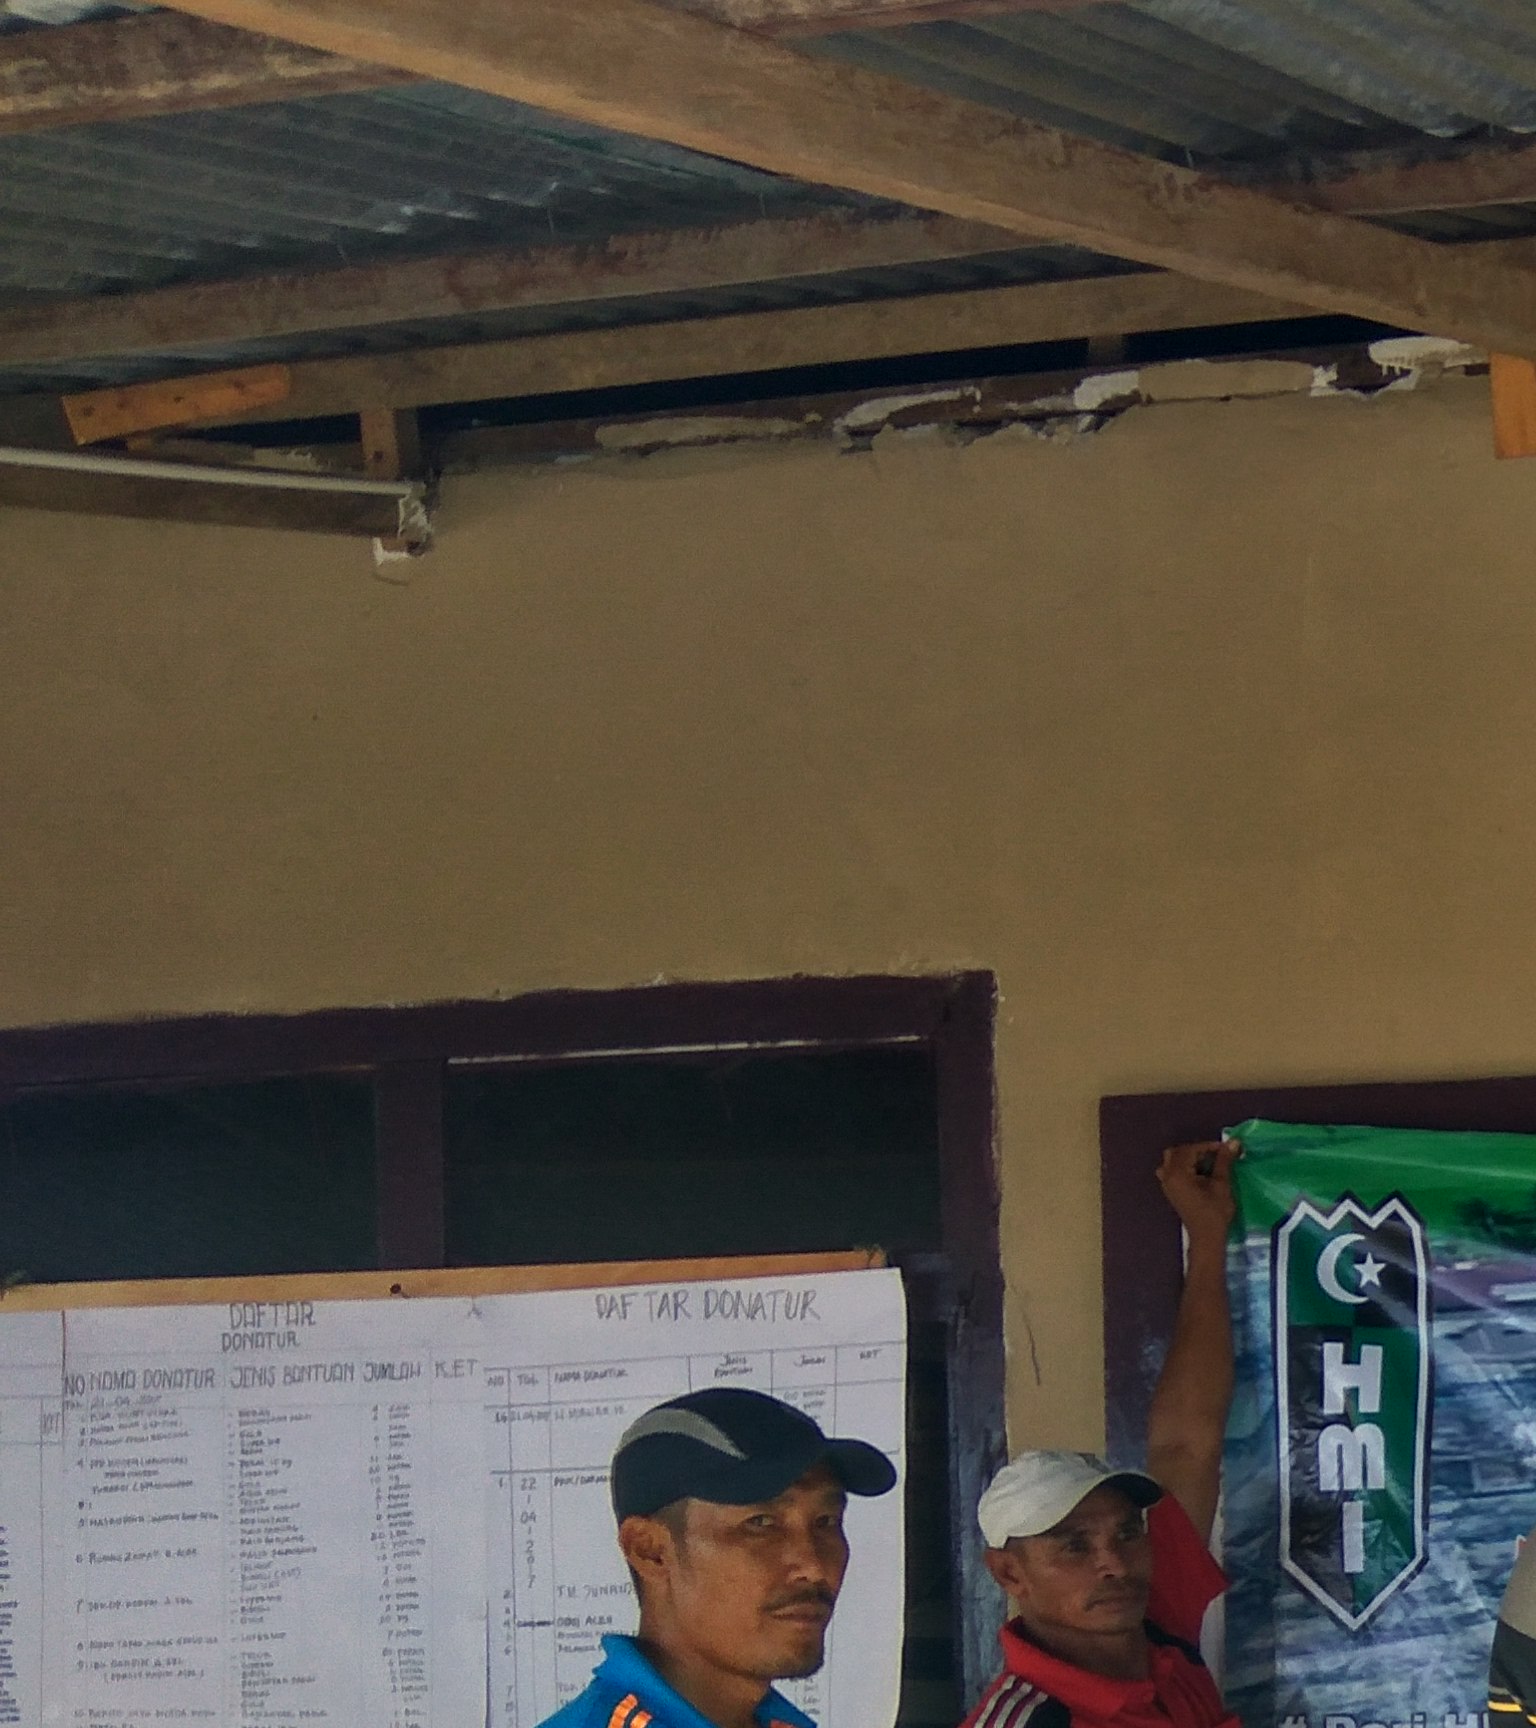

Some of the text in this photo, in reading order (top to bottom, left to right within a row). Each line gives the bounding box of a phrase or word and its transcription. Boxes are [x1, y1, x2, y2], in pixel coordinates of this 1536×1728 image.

[230, 1302, 316, 1330] DAFTAR
[703, 1288, 820, 1323] DONATUR
[221, 1331, 300, 1351] DONATUR
[1318, 1342, 1386, 1574] HMI
